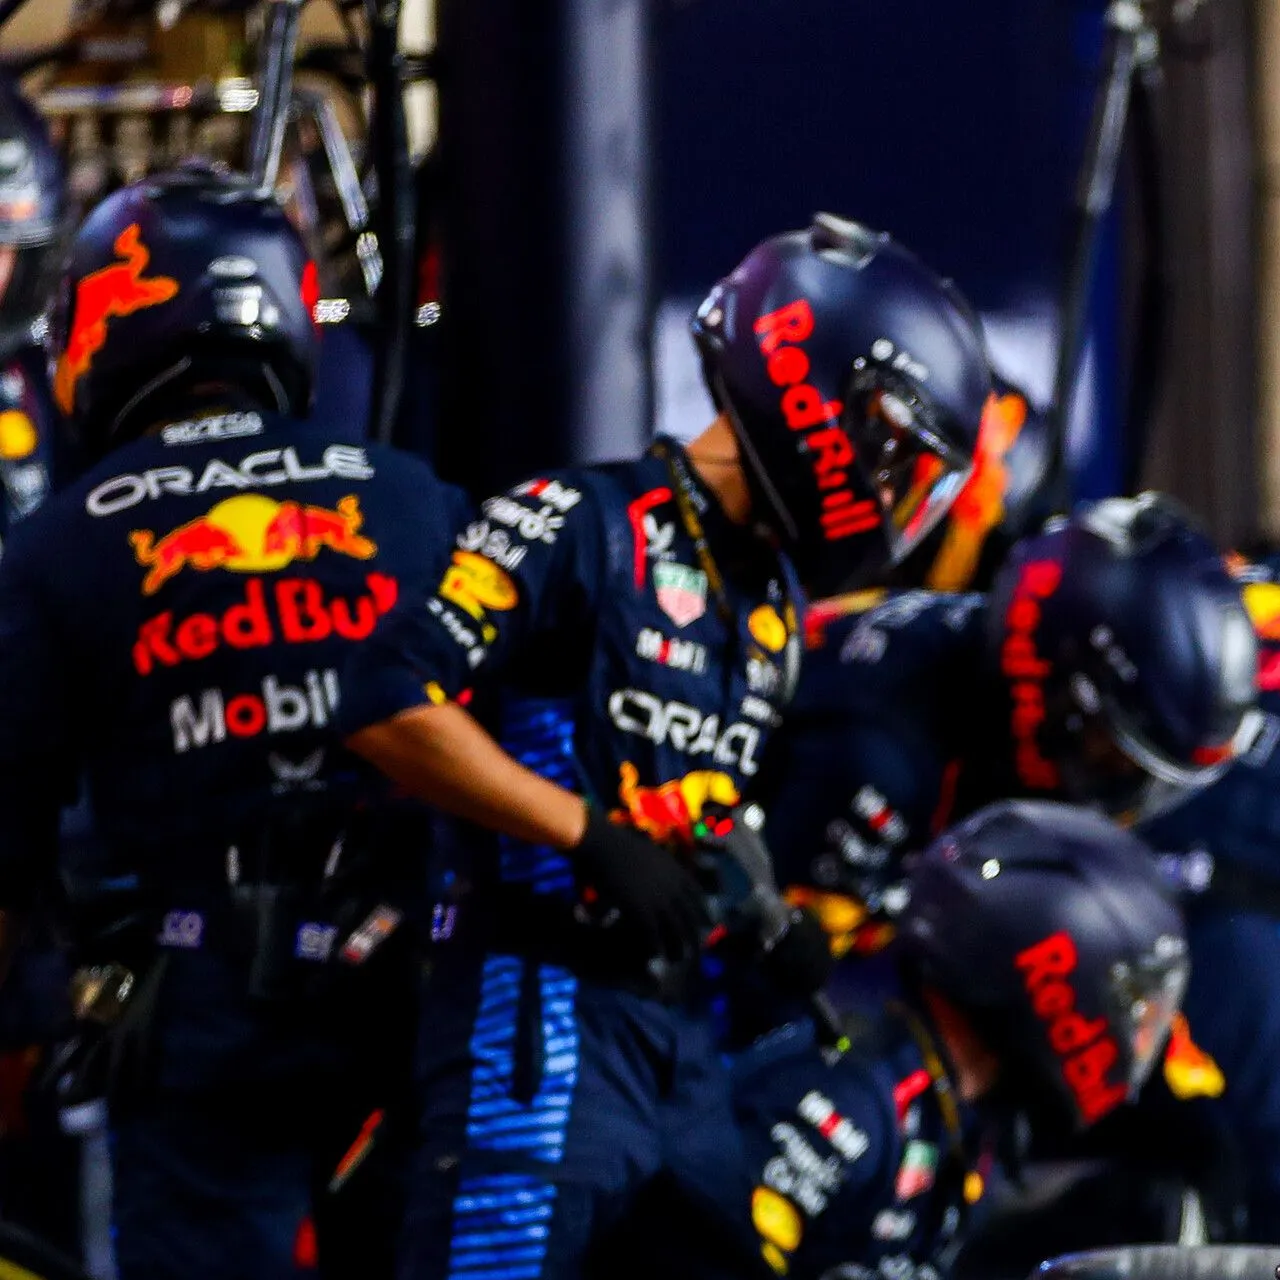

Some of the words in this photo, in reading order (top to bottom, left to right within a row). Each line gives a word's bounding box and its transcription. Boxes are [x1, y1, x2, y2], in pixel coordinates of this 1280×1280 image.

[85, 443, 376, 517] ORACLE
[169, 667, 339, 754] Mobil
[608, 687, 759, 776] ORACL
